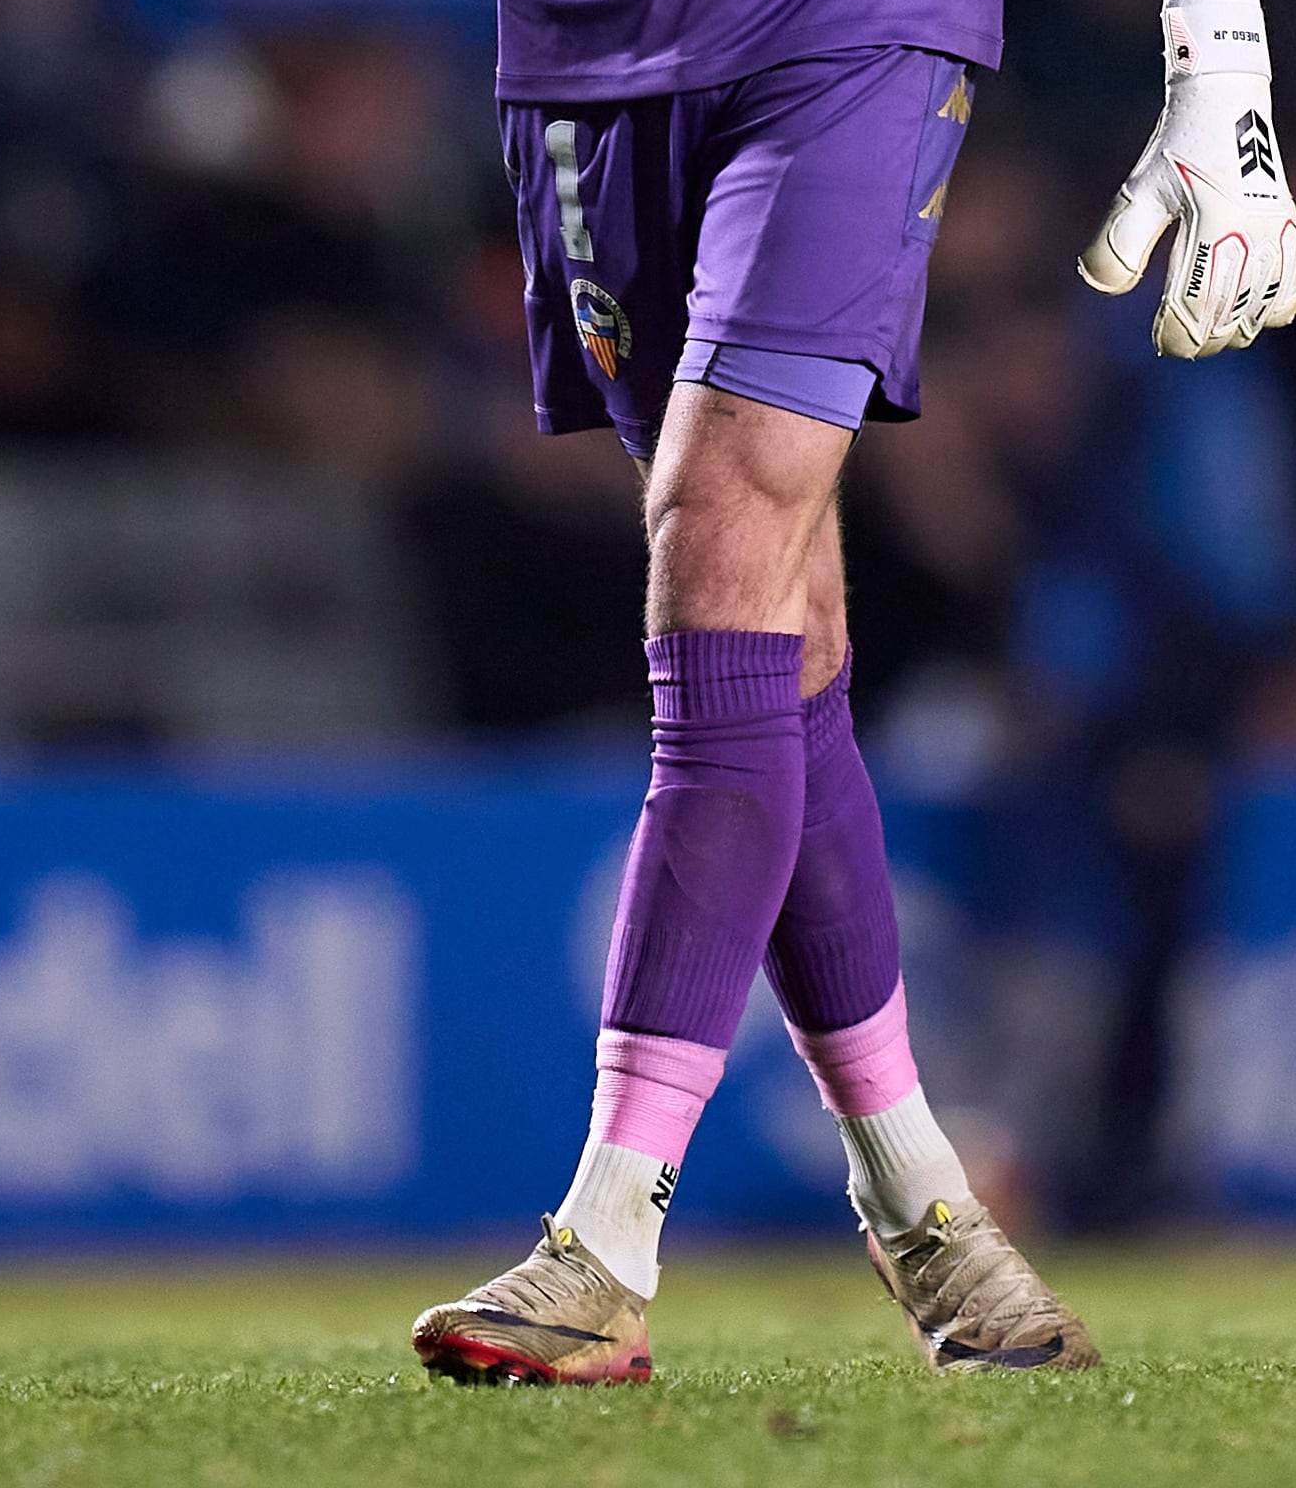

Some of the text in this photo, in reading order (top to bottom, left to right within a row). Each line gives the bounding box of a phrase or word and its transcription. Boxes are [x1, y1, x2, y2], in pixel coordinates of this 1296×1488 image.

[1213, 30, 1260, 43] DIEGO JR
[545, 119, 594, 263] 1
[1186, 241, 1211, 299] TWOFIVE
